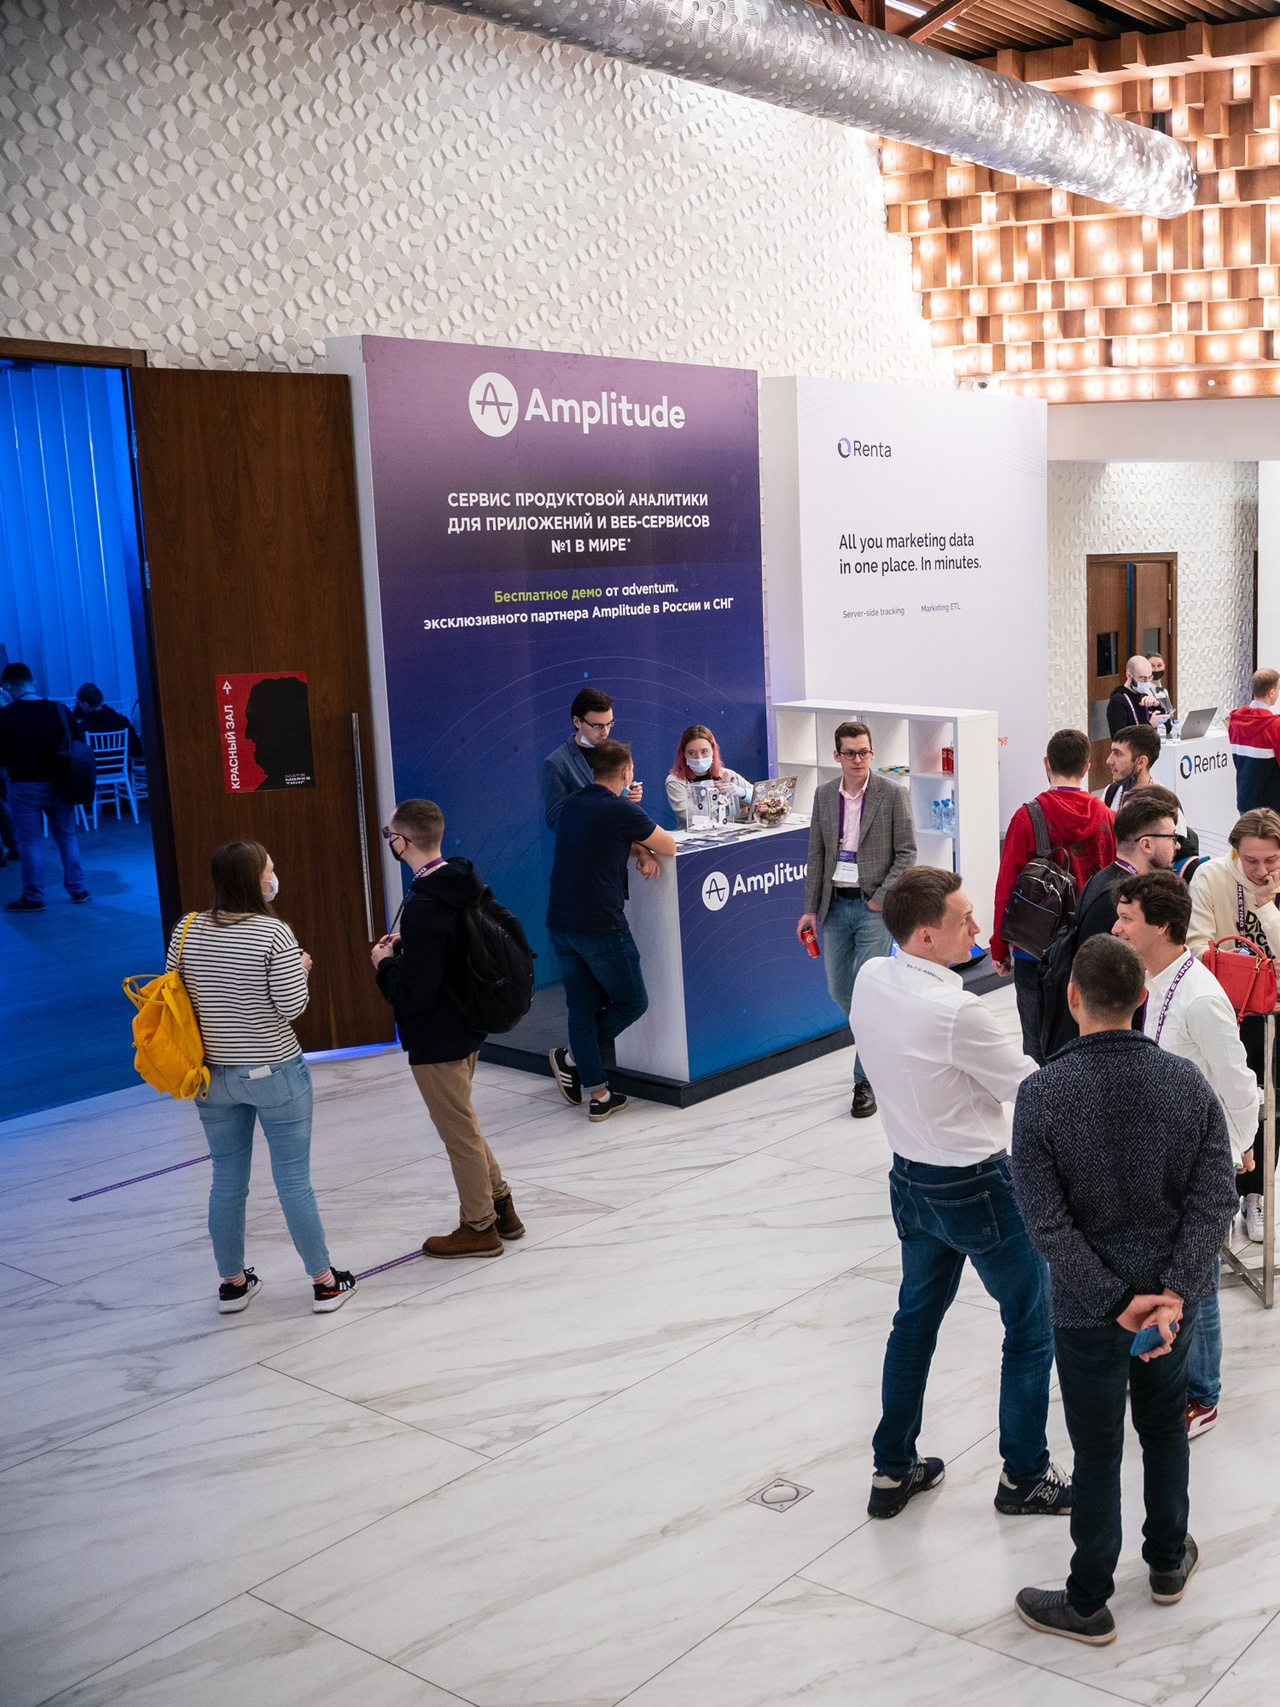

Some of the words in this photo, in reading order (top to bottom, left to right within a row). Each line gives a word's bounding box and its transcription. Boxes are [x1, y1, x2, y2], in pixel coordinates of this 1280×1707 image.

[525, 388, 686, 434] Amplitude
[853, 440, 892, 458] Renta
[447, 493, 511, 508] СЕРВИС
[515, 489, 625, 508] ПРОДУКТОВОЙ
[629, 492, 709, 507] АНАЛИТИКИ
[447, 516, 481, 534] ДЛЯ
[486, 513, 593, 531] ПРИЛОЖЕНИЙ
[598, 515, 607, 530] И
[611, 514, 710, 530] ВЕБ-СЕРВИСОВ
[551, 538, 571, 553] №1
[575, 539, 585, 552] В
[839, 534, 857, 550] All
[860, 536, 883, 553] you
[886, 533, 946, 551] marketing
[949, 532, 974, 548] data
[839, 559, 851, 575] in
[854, 560, 878, 573] one
[881, 557, 918, 576] place.
[921, 556, 932, 571] In
[935, 555, 982, 570] minutes.
[494, 588, 569, 604] Бесплатное
[571, 586, 603, 601] демо
[605, 586, 619, 598] от
[424, 610, 528, 630] эксклюзивного
[531, 608, 589, 625] партнера
[592, 603, 651, 620] Amplitude
[653, 604, 660, 614] в
[662, 599, 702, 613] России
[704, 600, 711, 610] и
[713, 597, 734, 610] СНГ
[843, 608, 879, 618] Server-side
[880, 606, 905, 617] tracking
[921, 603, 949, 613] Marketing
[950, 602, 961, 611] ETL
[224, 704, 236, 730] ЗАЛ
[225, 731, 240, 790] КРАСНЫЙ
[1194, 751, 1228, 774] Renta
